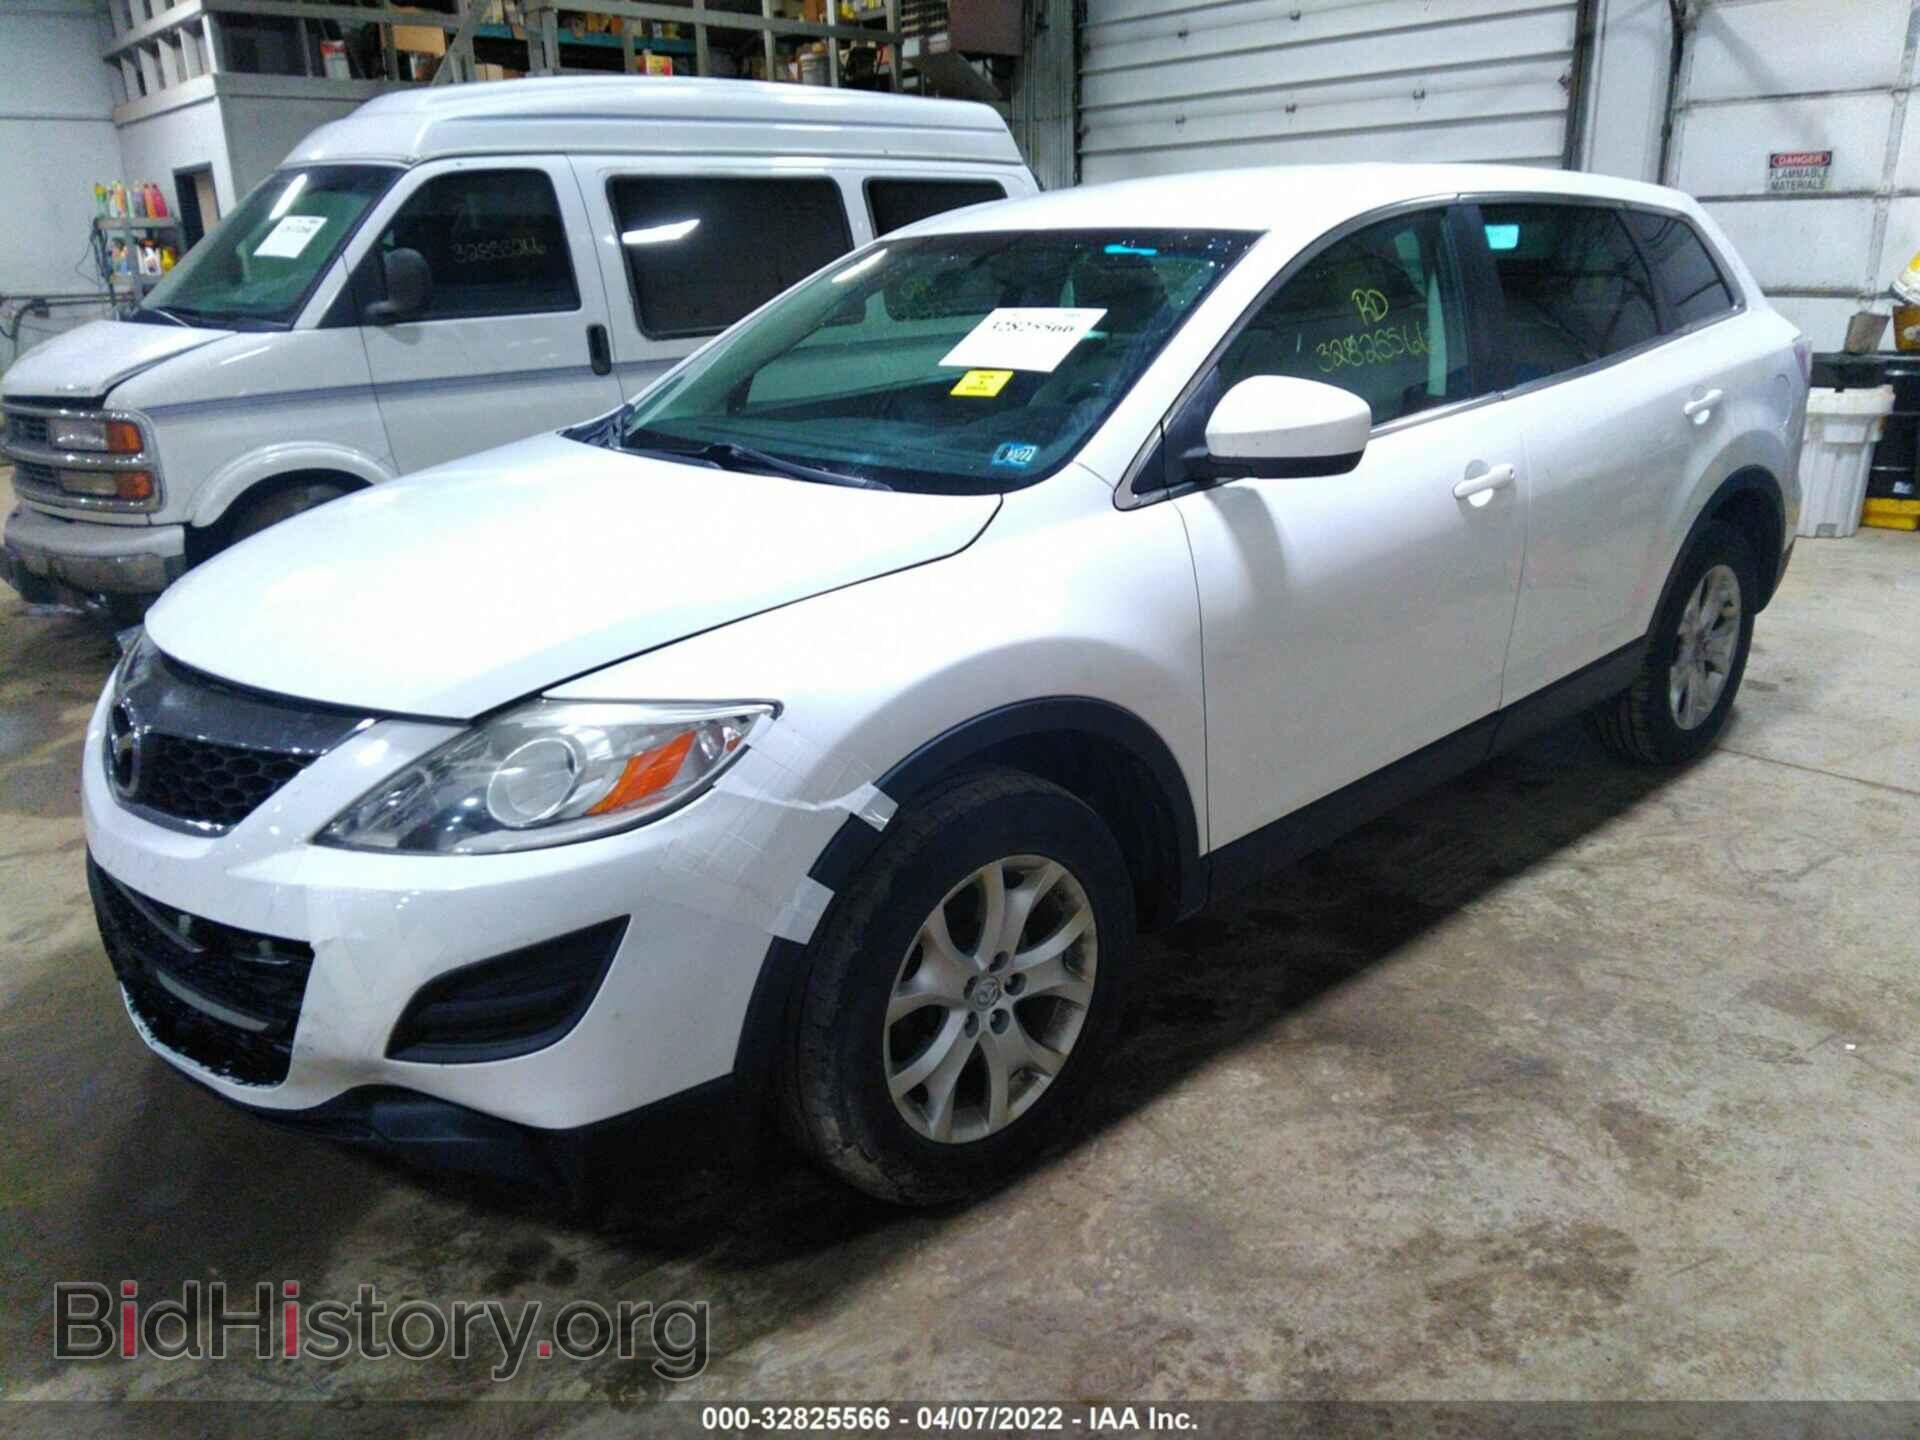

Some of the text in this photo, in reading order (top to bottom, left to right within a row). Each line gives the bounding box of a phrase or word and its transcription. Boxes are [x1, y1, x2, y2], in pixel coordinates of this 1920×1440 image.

[1778, 153, 1823, 166] DANGER
[1770, 167, 1829, 179] FLAMMABLE
[1771, 179, 1824, 191] MATERIALS
